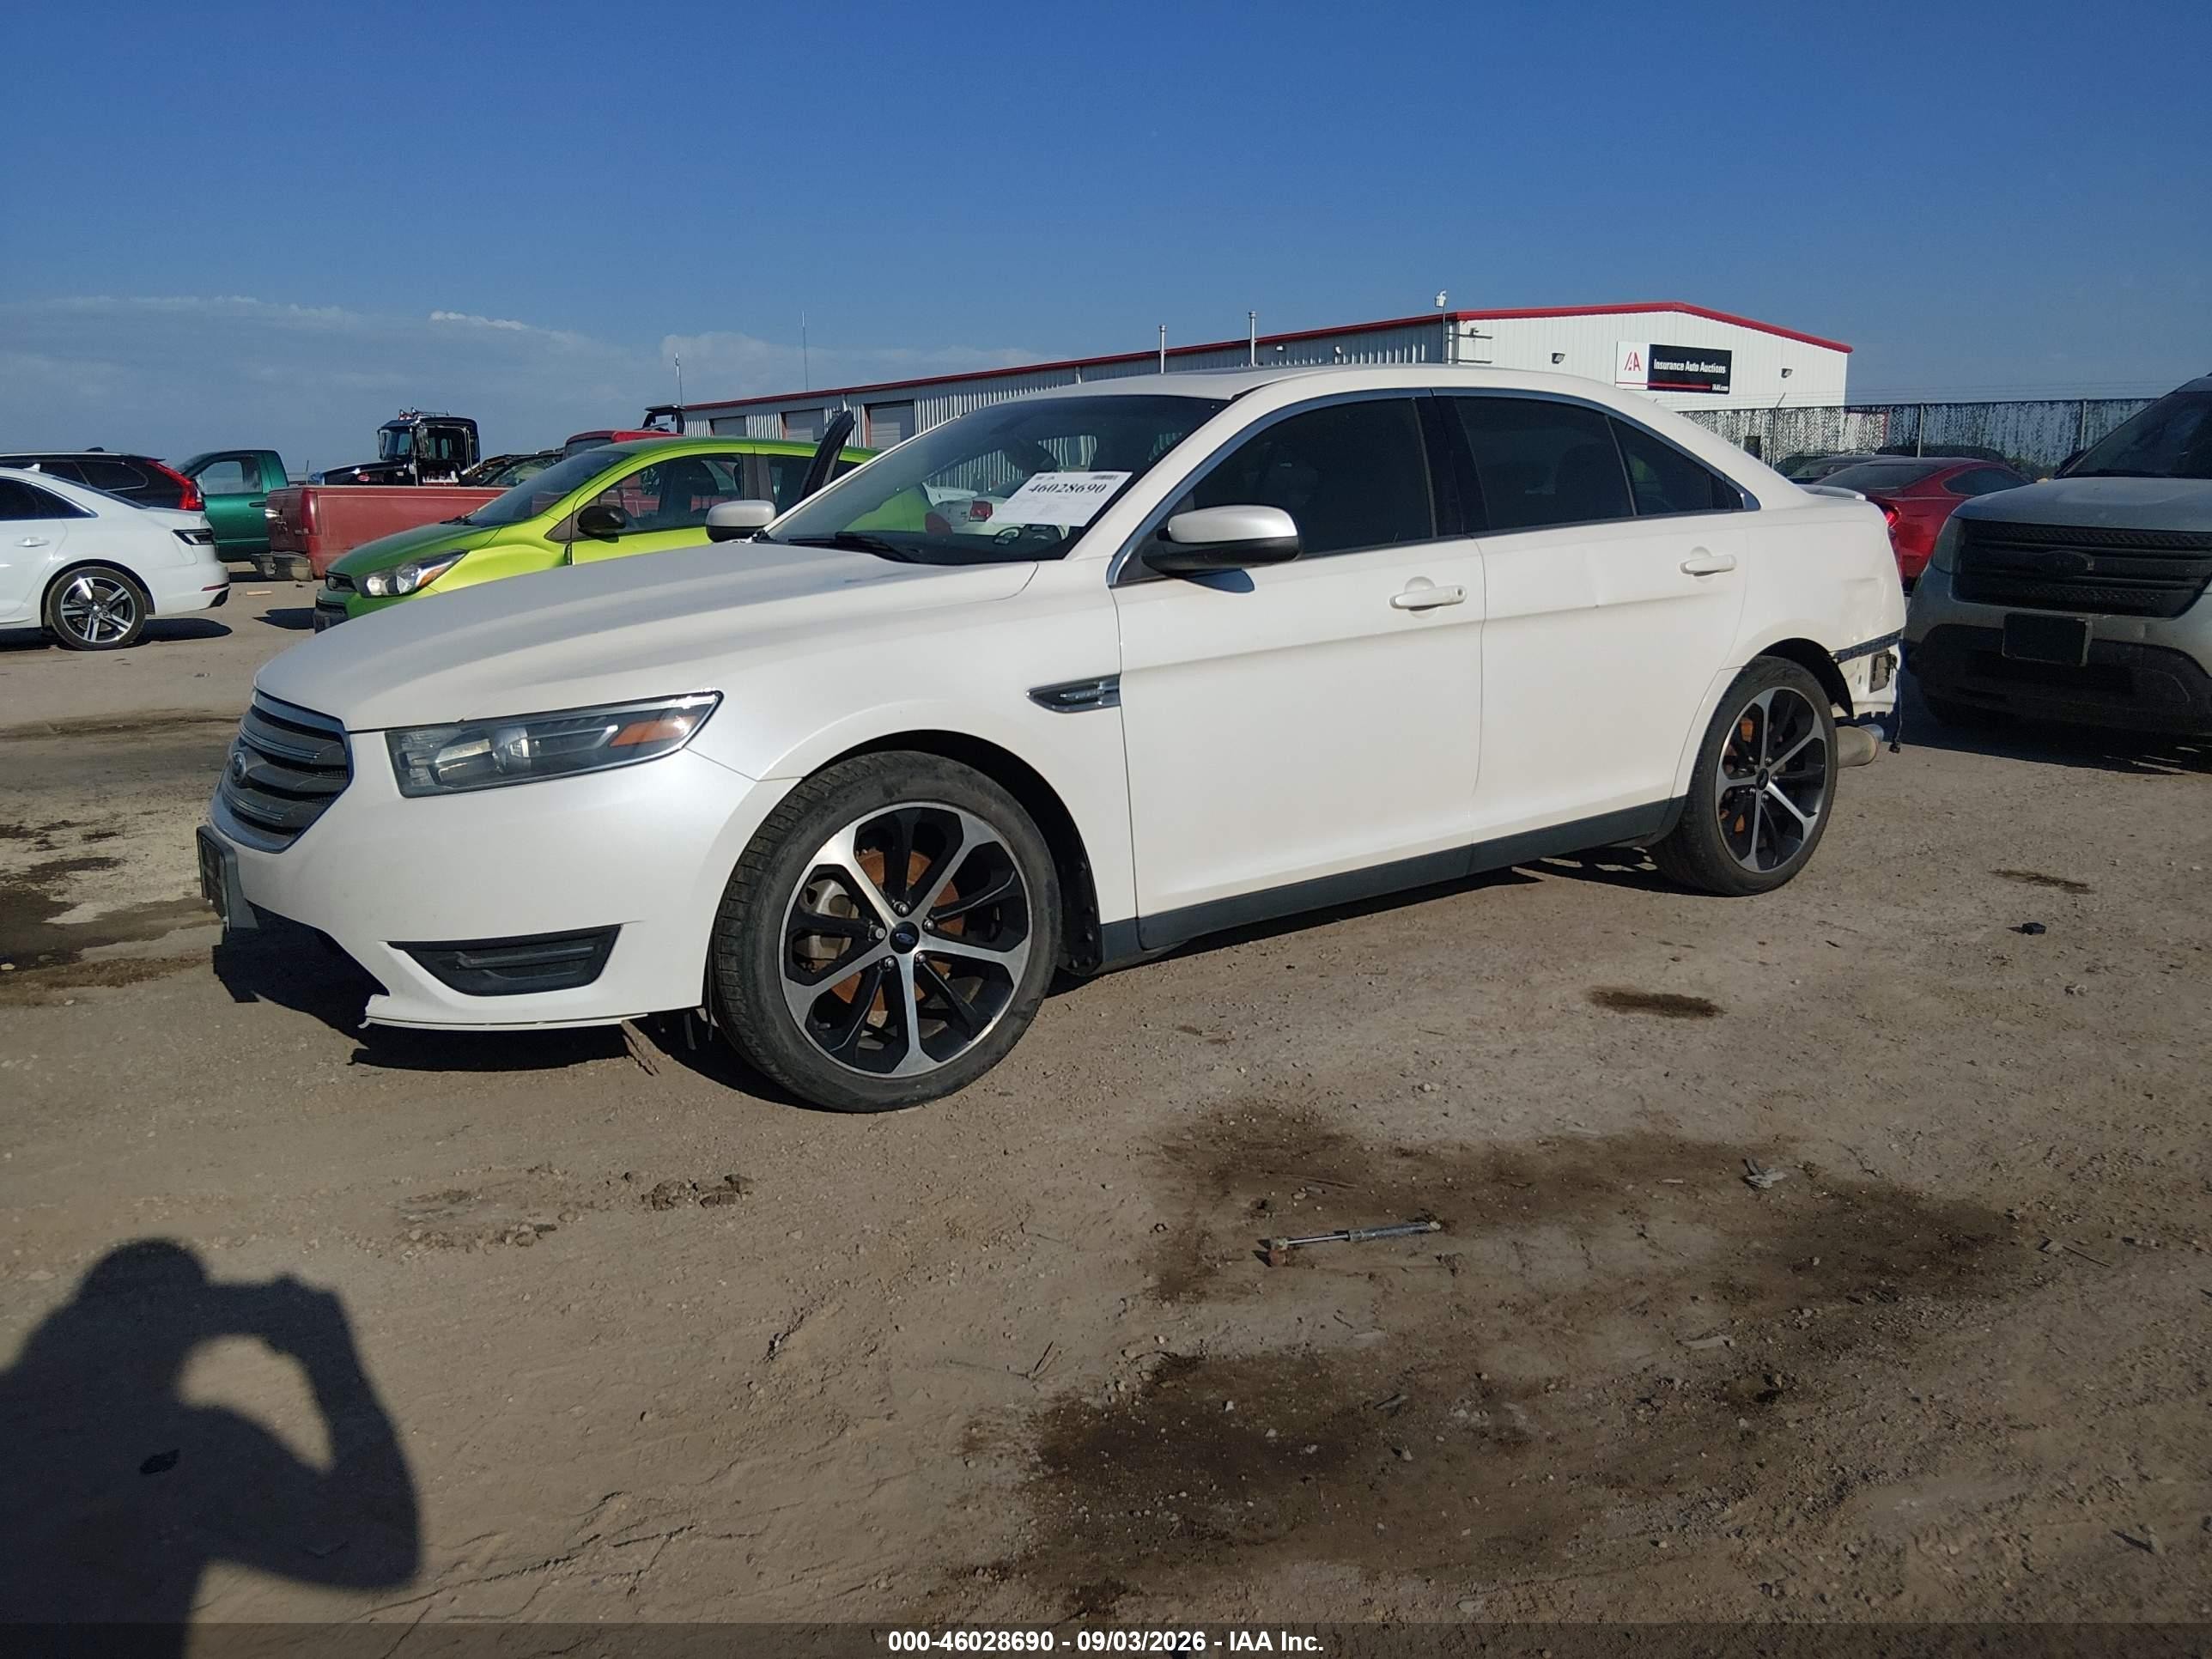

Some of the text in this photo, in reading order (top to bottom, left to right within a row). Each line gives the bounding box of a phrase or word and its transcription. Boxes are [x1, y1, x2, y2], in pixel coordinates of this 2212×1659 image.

[1654, 358, 1726, 374] Insurance Auto Auctions
[1029, 483, 1107, 494] 46028690
